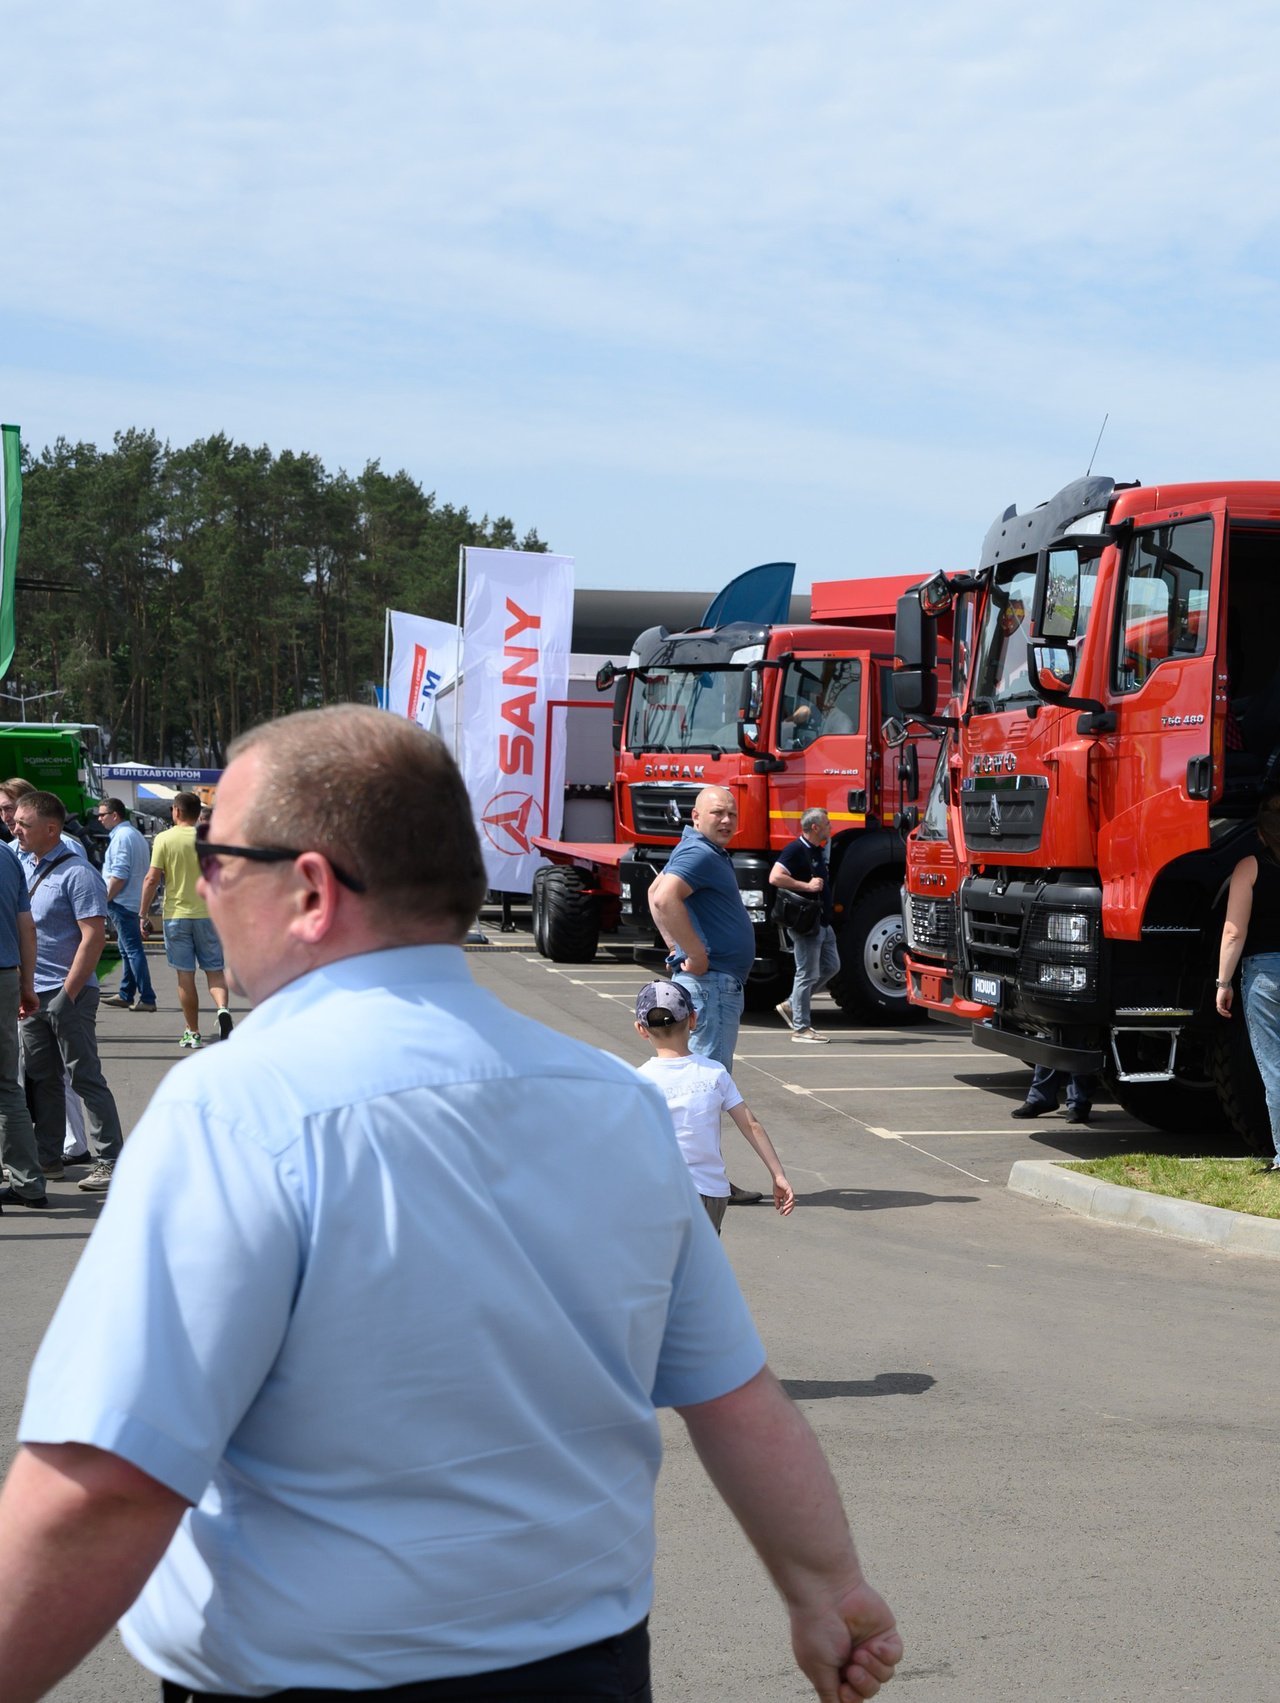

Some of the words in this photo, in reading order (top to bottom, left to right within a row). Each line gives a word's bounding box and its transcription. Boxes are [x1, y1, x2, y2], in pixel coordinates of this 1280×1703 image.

[499, 596, 541, 776] SANY
[1183, 714, 1205, 725] 480
[973, 752, 1017, 774] HOWO
[113, 768, 201, 779] БЕЛТЕХАВТОПРОМ
[645, 764, 705, 778] SITRAK
[920, 872, 947, 886] HOWO
[975, 978, 997, 996] HOWO
